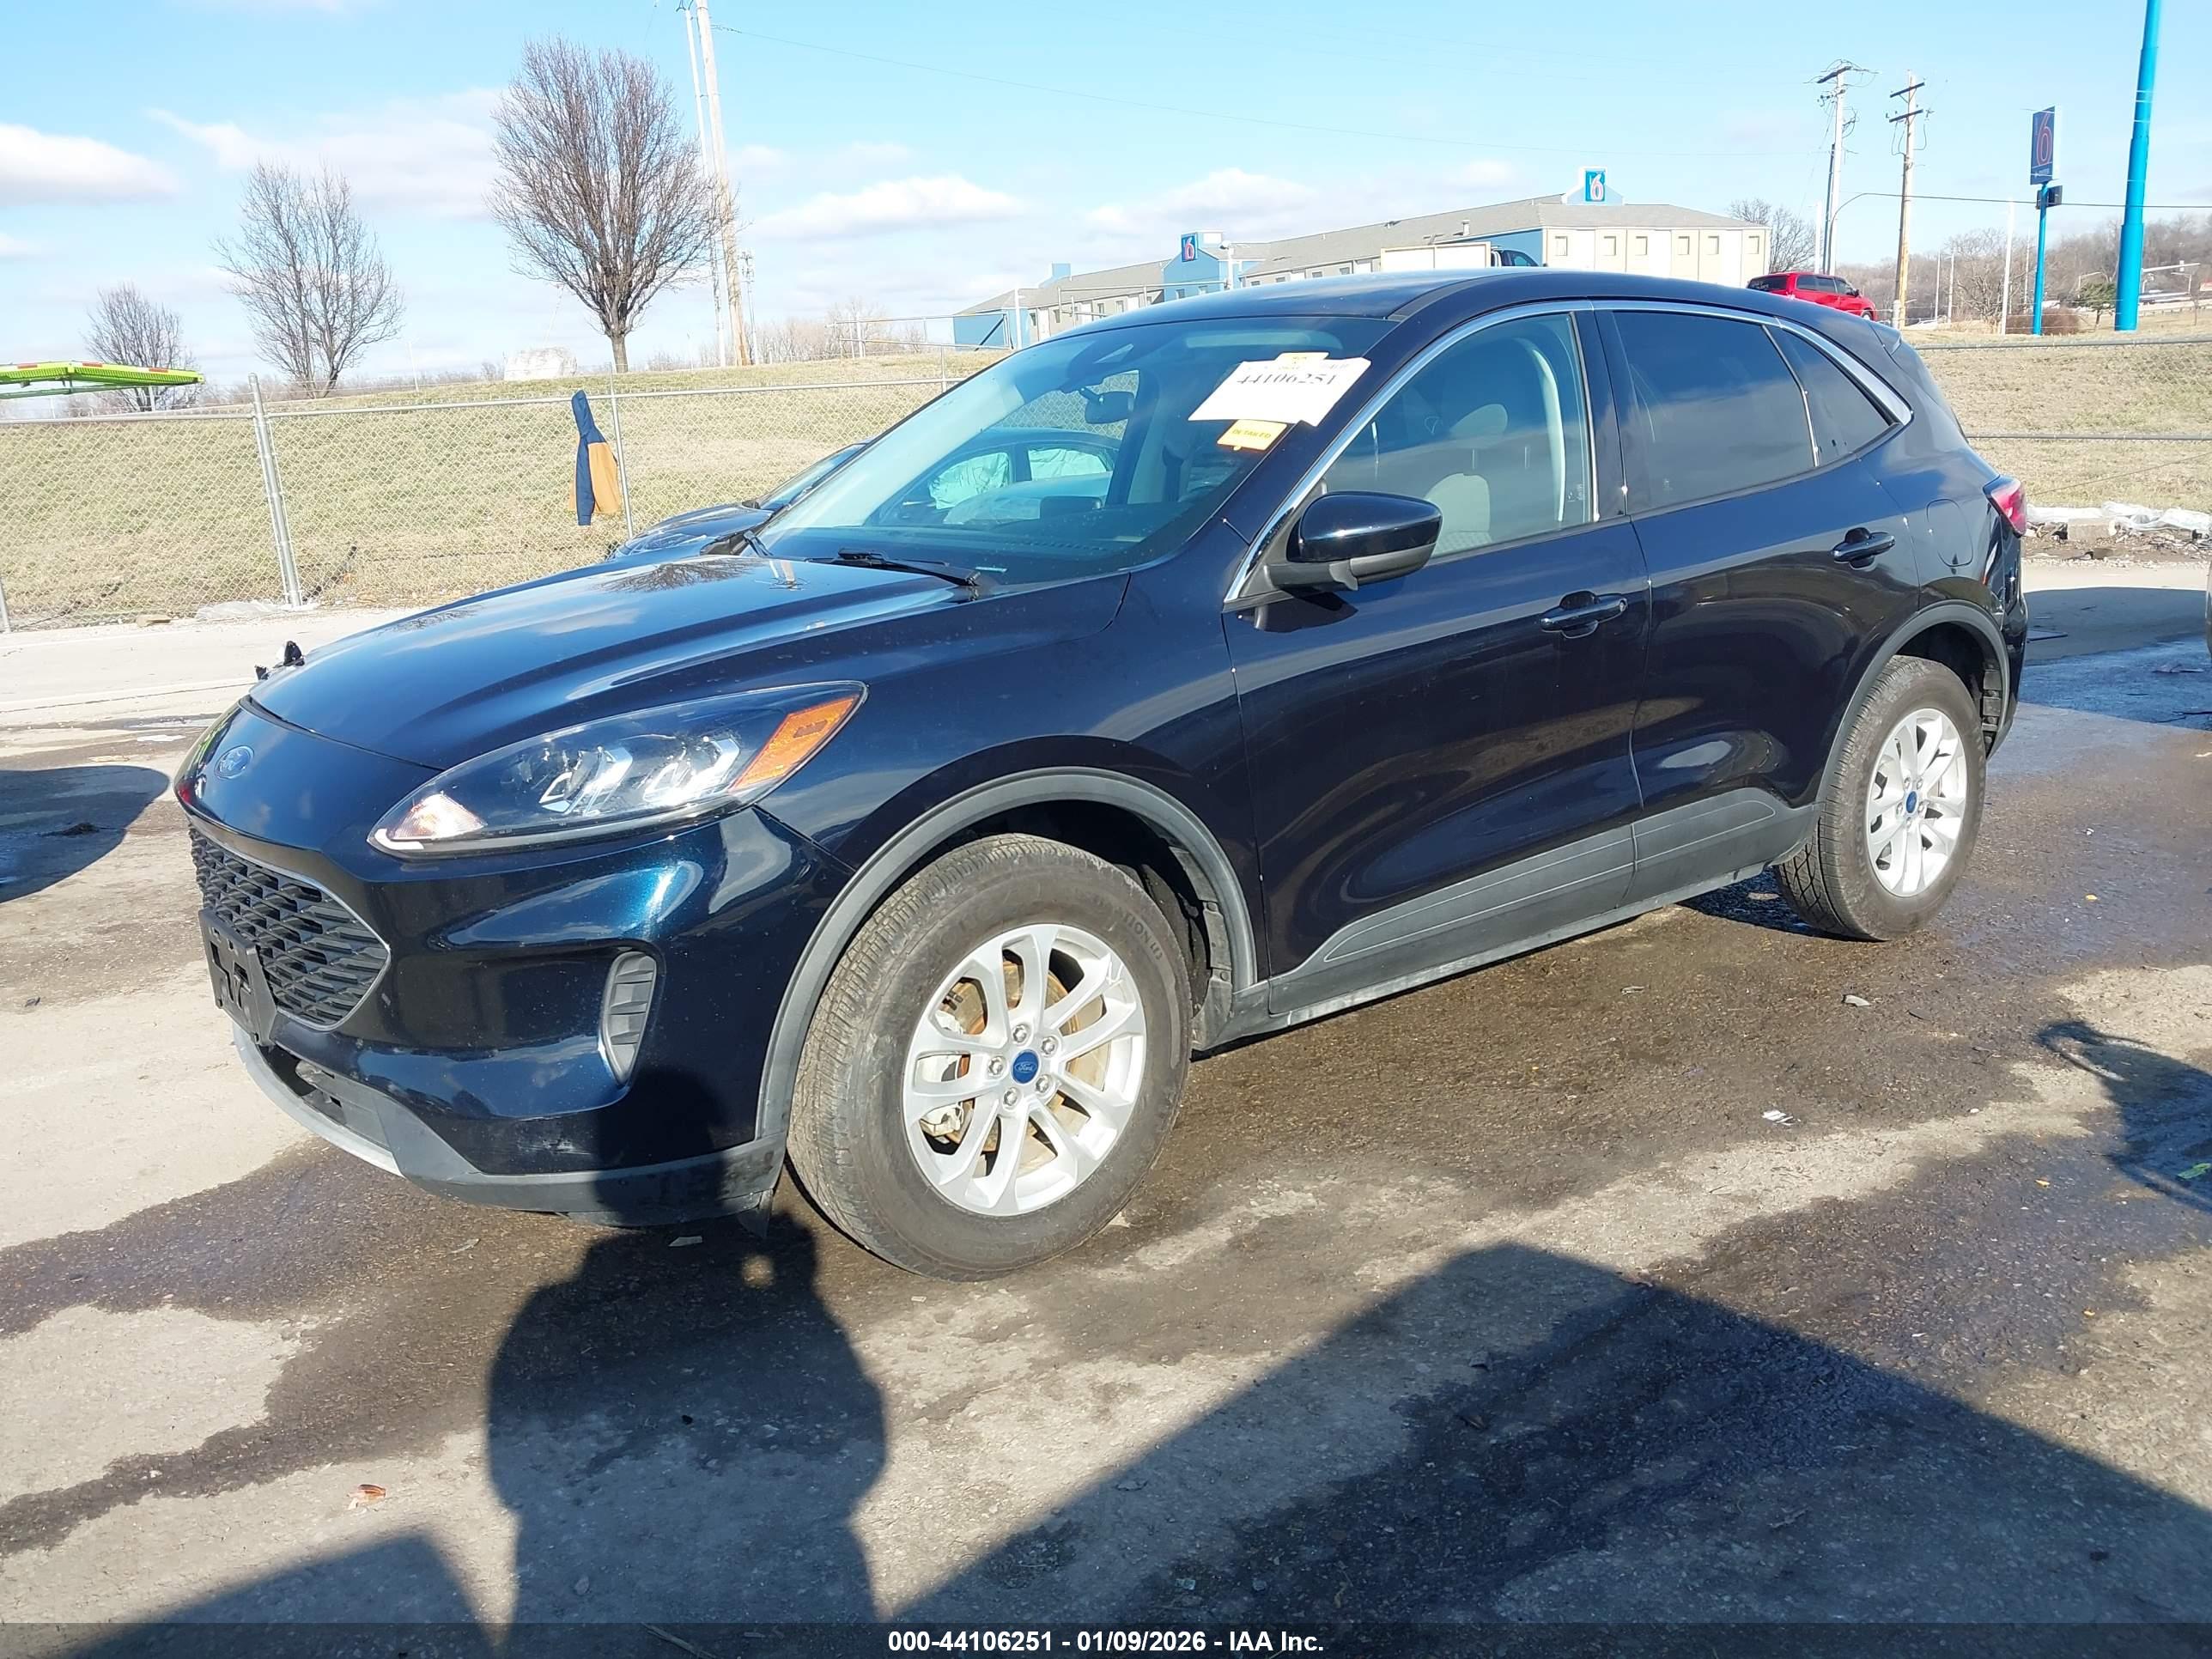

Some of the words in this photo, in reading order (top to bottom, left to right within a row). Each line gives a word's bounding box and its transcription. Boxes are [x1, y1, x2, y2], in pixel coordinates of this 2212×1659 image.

[2036, 112, 2053, 166] 6
[1590, 173, 1604, 201] 6
[1185, 236, 1195, 261] 6
